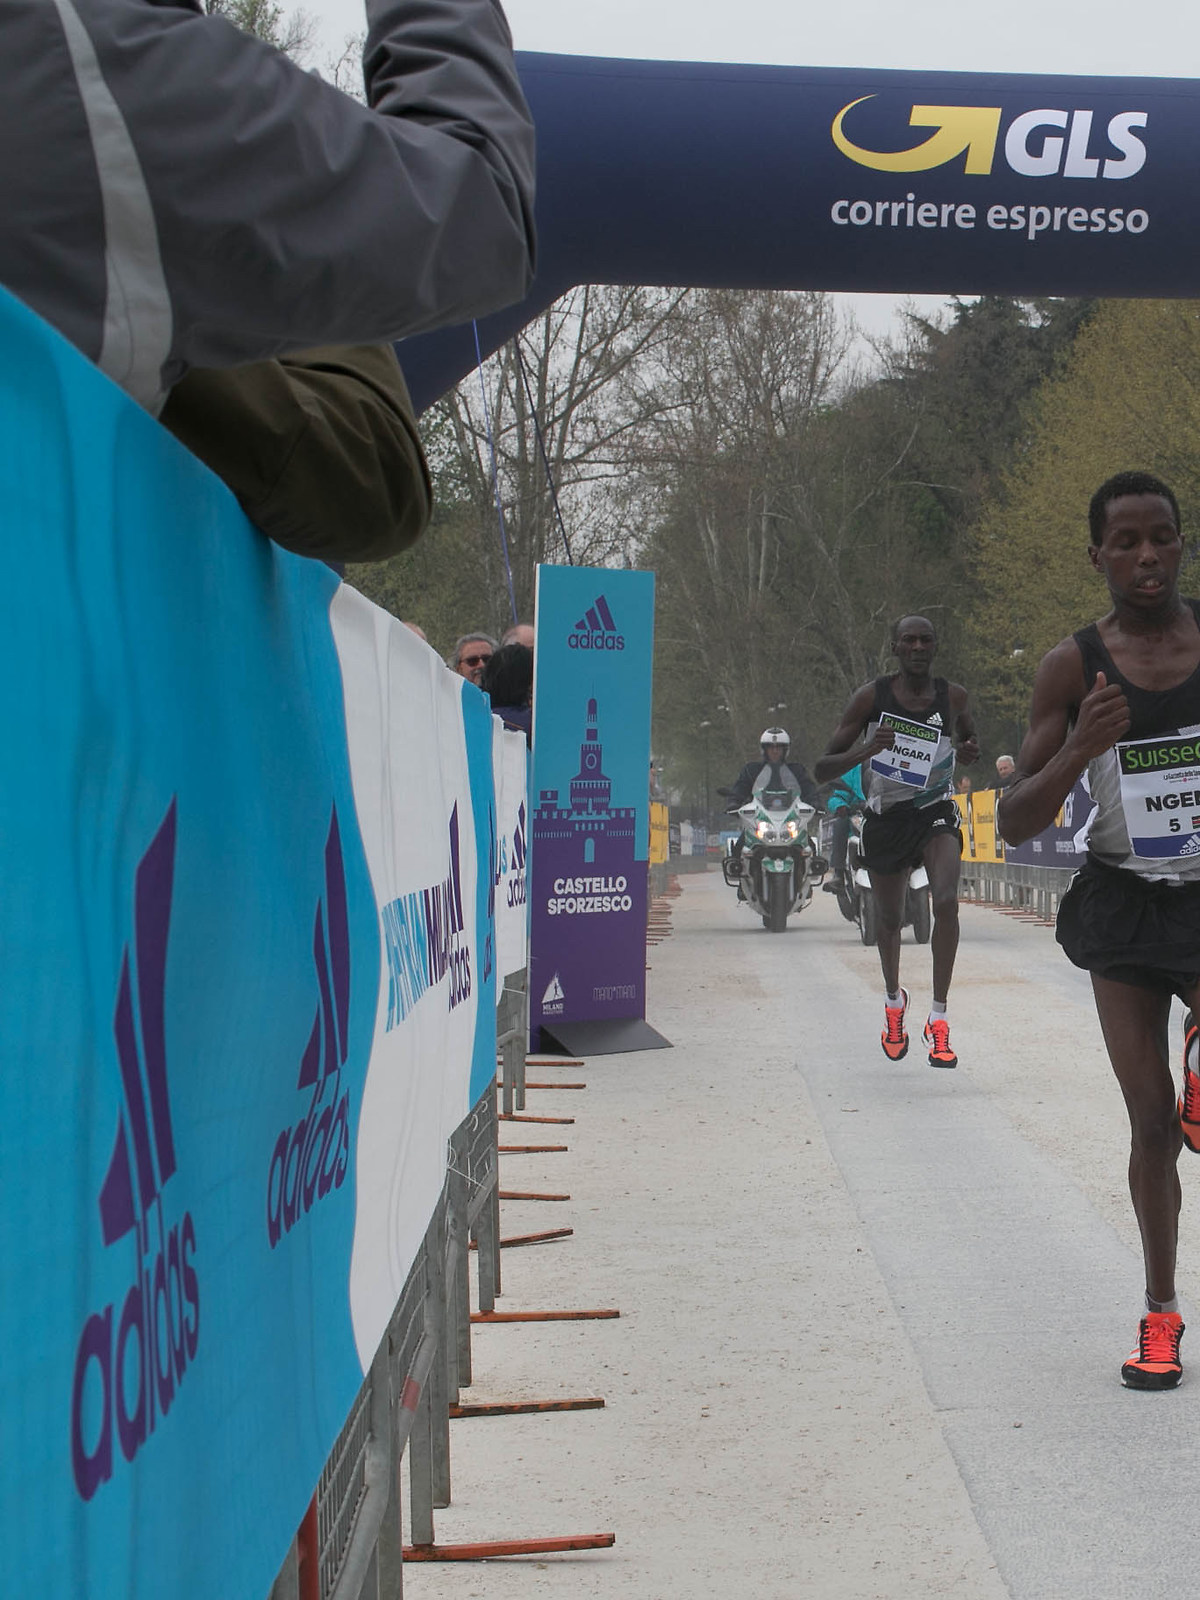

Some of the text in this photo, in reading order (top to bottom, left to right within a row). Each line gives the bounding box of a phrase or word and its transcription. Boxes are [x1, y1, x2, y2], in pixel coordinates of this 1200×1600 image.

[1004, 108, 1149, 180] GLS
[830, 192, 1149, 240] corriere espresso
[567, 629, 625, 651] adidas
[890, 757, 896, 766] 1
[1169, 818, 1181, 833] 5
[554, 876, 627, 895] CASTELLO
[547, 895, 633, 915] SFORZESCO
[265, 1066, 351, 1250] adidas
[70, 1192, 199, 1502] adidas
